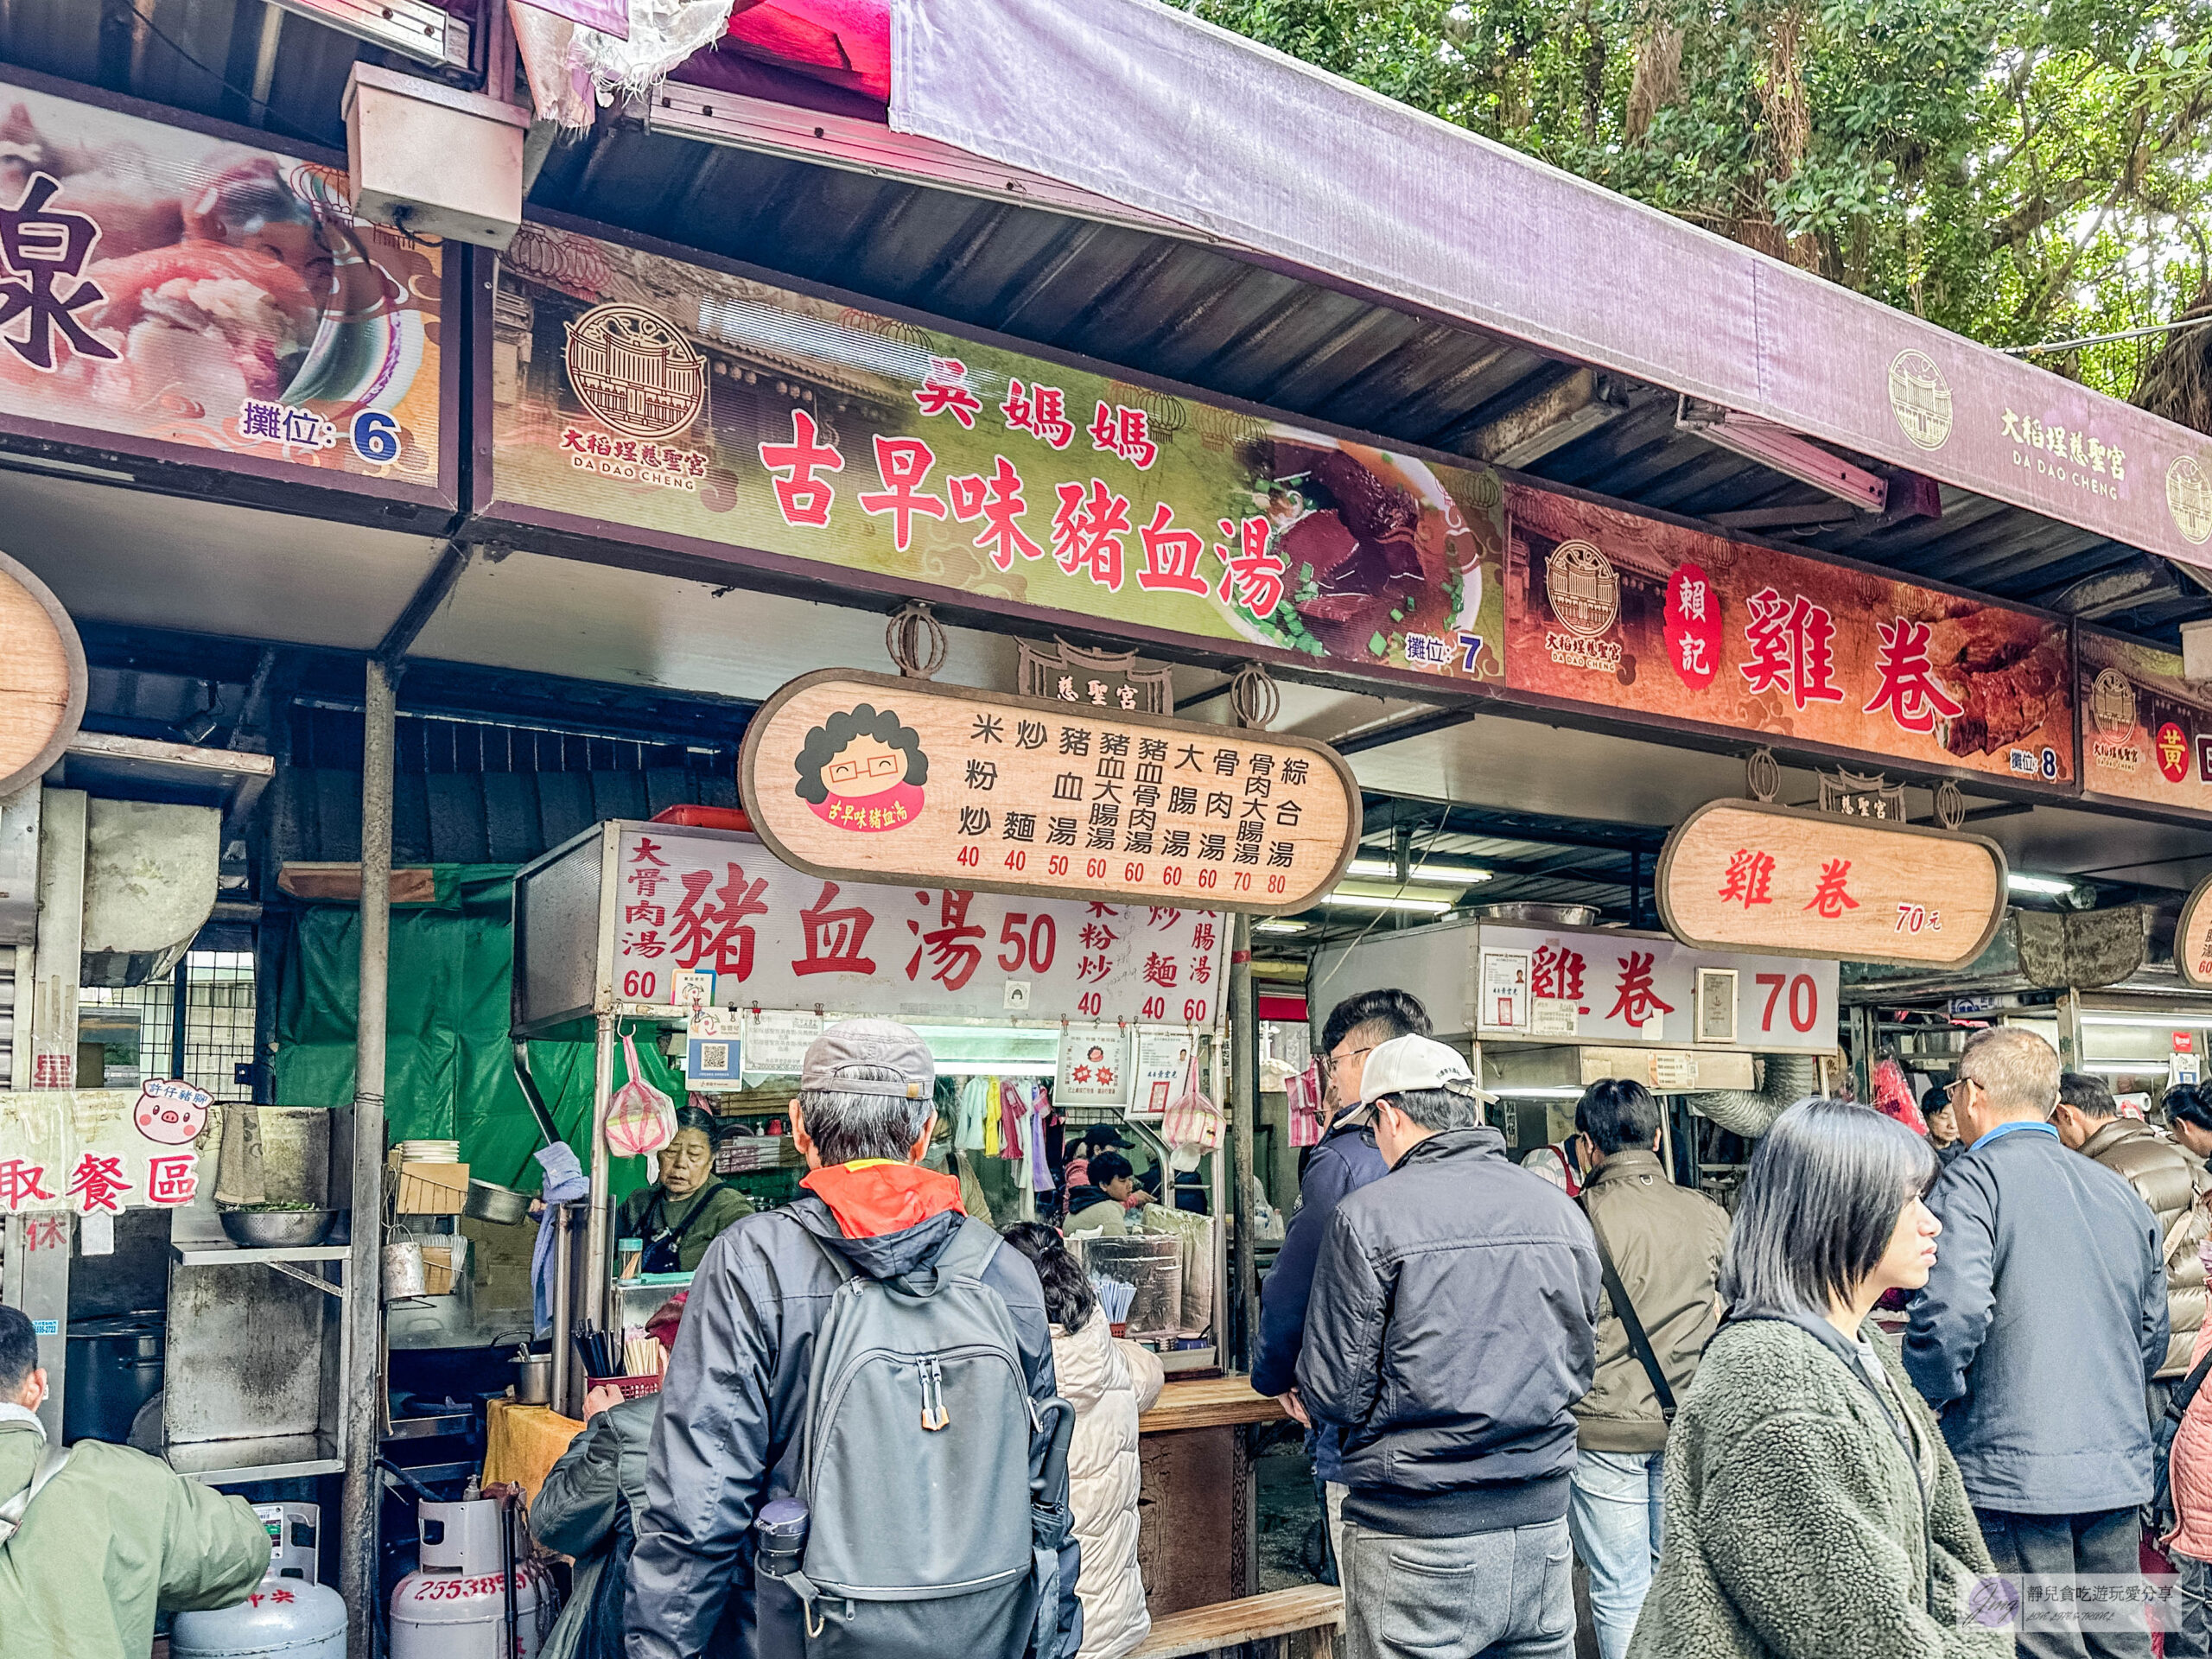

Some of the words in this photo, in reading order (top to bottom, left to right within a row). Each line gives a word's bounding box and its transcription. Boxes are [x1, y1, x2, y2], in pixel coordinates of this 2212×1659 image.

[0, 175, 121, 370] 泉
[354, 412, 397, 460] 6
[562, 429, 708, 478] 大稻埕慈聖宮
[2001, 407, 2126, 481] 大稻埕慈聖宮
[574, 457, 594, 470] DA
[602, 463, 634, 477] DAO
[641, 471, 694, 490] CHENG
[2012, 450, 2031, 470] DA
[2037, 459, 2066, 481] DAO
[2072, 473, 2118, 500] CHENG
[761, 410, 1286, 620] 古早味豬血湯
[1678, 576, 1710, 675] 賴記
[1459, 635, 1482, 670] 7
[1546, 633, 1621, 661] 大稻埕慈聖宮
[1553, 653, 1563, 662] DA
[1567, 656, 1583, 665] DAO
[1586, 659, 1615, 671] CHENG
[1738, 588, 1965, 733] 雞卷
[1056, 676, 1139, 712] 慈聖宮
[2043, 749, 2056, 777] 8
[2159, 729, 2186, 775] 黃
[957, 714, 1004, 836] 米粉炒
[1002, 719, 1047, 843] 炒麵
[1046, 726, 1091, 847] 豬血湯
[1085, 731, 1130, 852] 豬血大腸湯
[1124, 736, 1168, 855] 豬血骨肉湯
[828, 799, 907, 830] 古早味豬血湯
[1160, 742, 1205, 859] 大腸湯
[1197, 747, 1240, 862] 骨肉湯
[1233, 752, 1275, 866] 骨肉大腸湯
[1266, 757, 1309, 868] 綜合湯
[1841, 794, 1887, 820] 慈聖宮
[957, 846, 980, 868] 40
[1004, 849, 1027, 872] 40
[1048, 855, 1069, 876] 50
[1086, 858, 1107, 880] 60
[1124, 861, 1145, 883] 60
[1162, 865, 1183, 887] 60
[621, 837, 671, 960] 大骨肉湯
[1198, 868, 1217, 889] 60
[1234, 872, 1251, 893] 70
[1267, 874, 1286, 895] 80
[1718, 849, 1860, 918] 雞卷
[669, 861, 987, 992] 豬血湯
[997, 912, 1057, 975] 50
[1895, 903, 1942, 935] 70元
[1142, 906, 1181, 988] 炒麵
[2199, 960, 2212, 975] 60
[623, 969, 657, 999] 60
[1077, 992, 1102, 1016] 40
[1532, 945, 1675, 1028] 雞卷
[1756, 974, 1818, 1033] 70
[1141, 995, 1165, 1020] 40
[1184, 998, 1206, 1022] 60
[0, 1154, 196, 1211] 取餐區
[26, 1217, 67, 1251] 休
